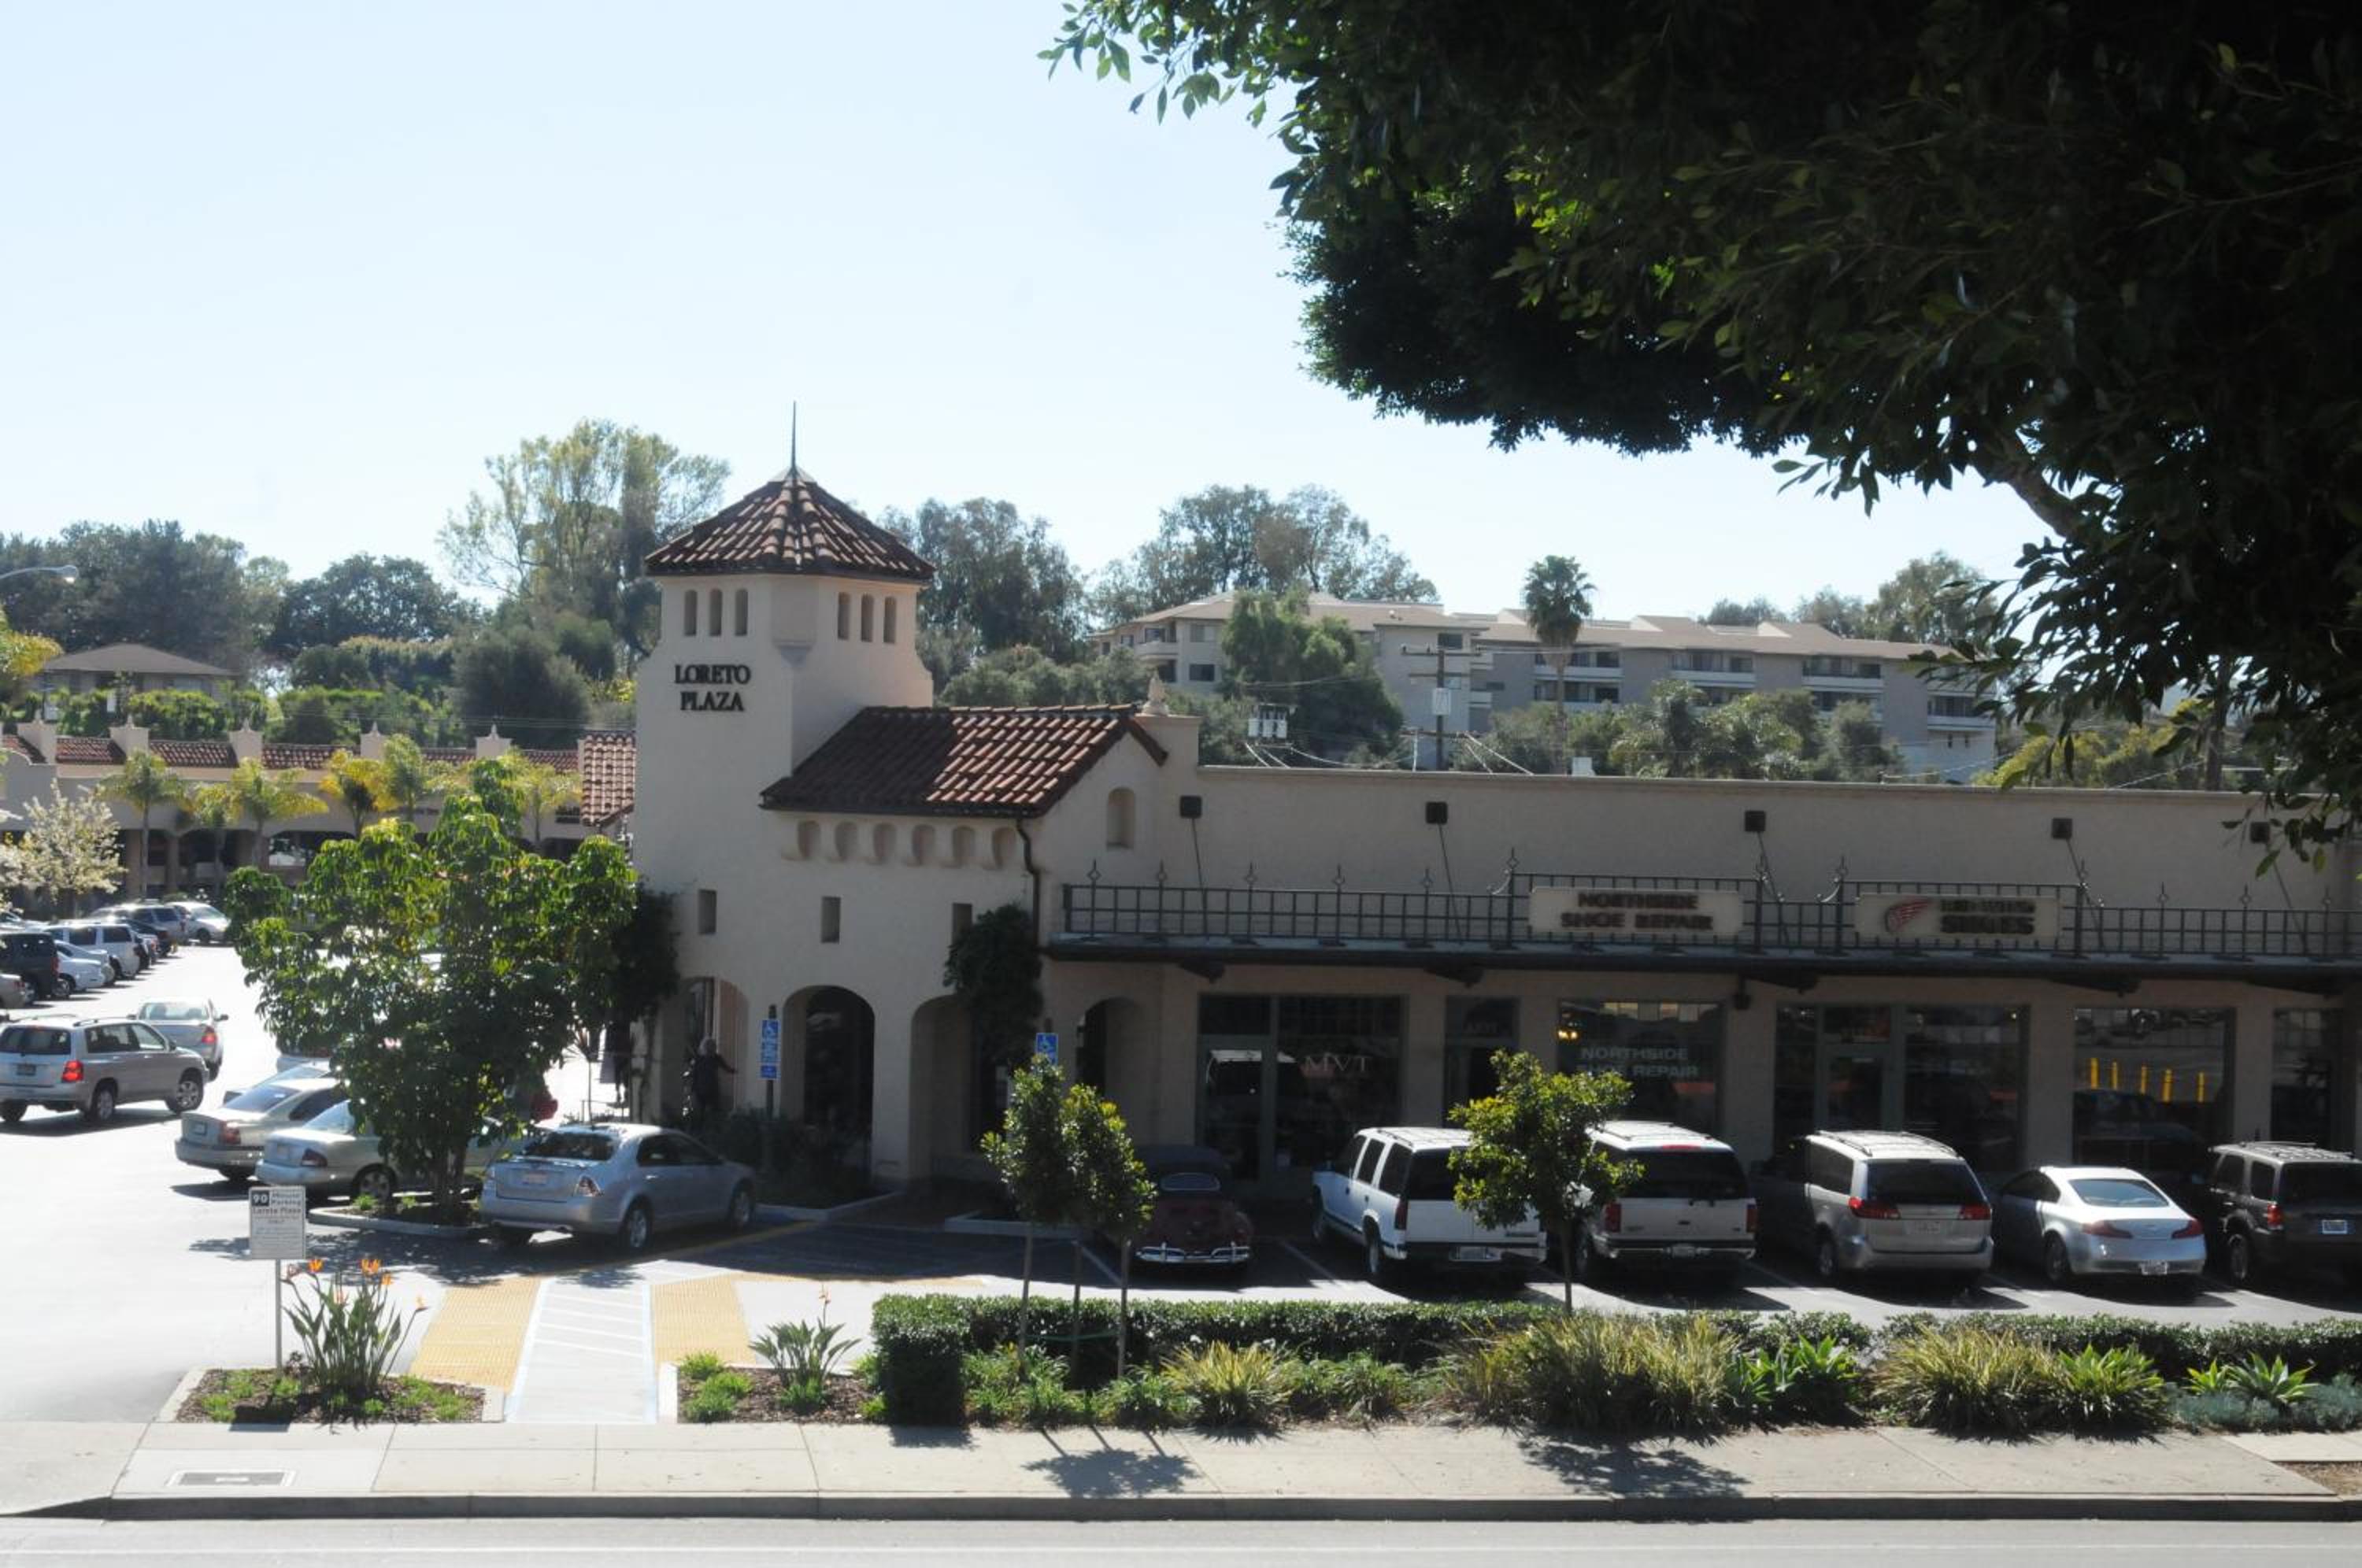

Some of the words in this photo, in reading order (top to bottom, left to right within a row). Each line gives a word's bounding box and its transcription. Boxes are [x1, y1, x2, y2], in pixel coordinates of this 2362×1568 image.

[674, 664, 751, 684] LORETO
[679, 691, 745, 712] PLAZA
[1561, 912, 1625, 928] SHOE
[1635, 914, 1713, 930] REPAIR
[1581, 1047, 1688, 1060] NORTHSIDE
[1632, 1065, 1698, 1078] REPAIR
[253, 1193, 268, 1204] 90
